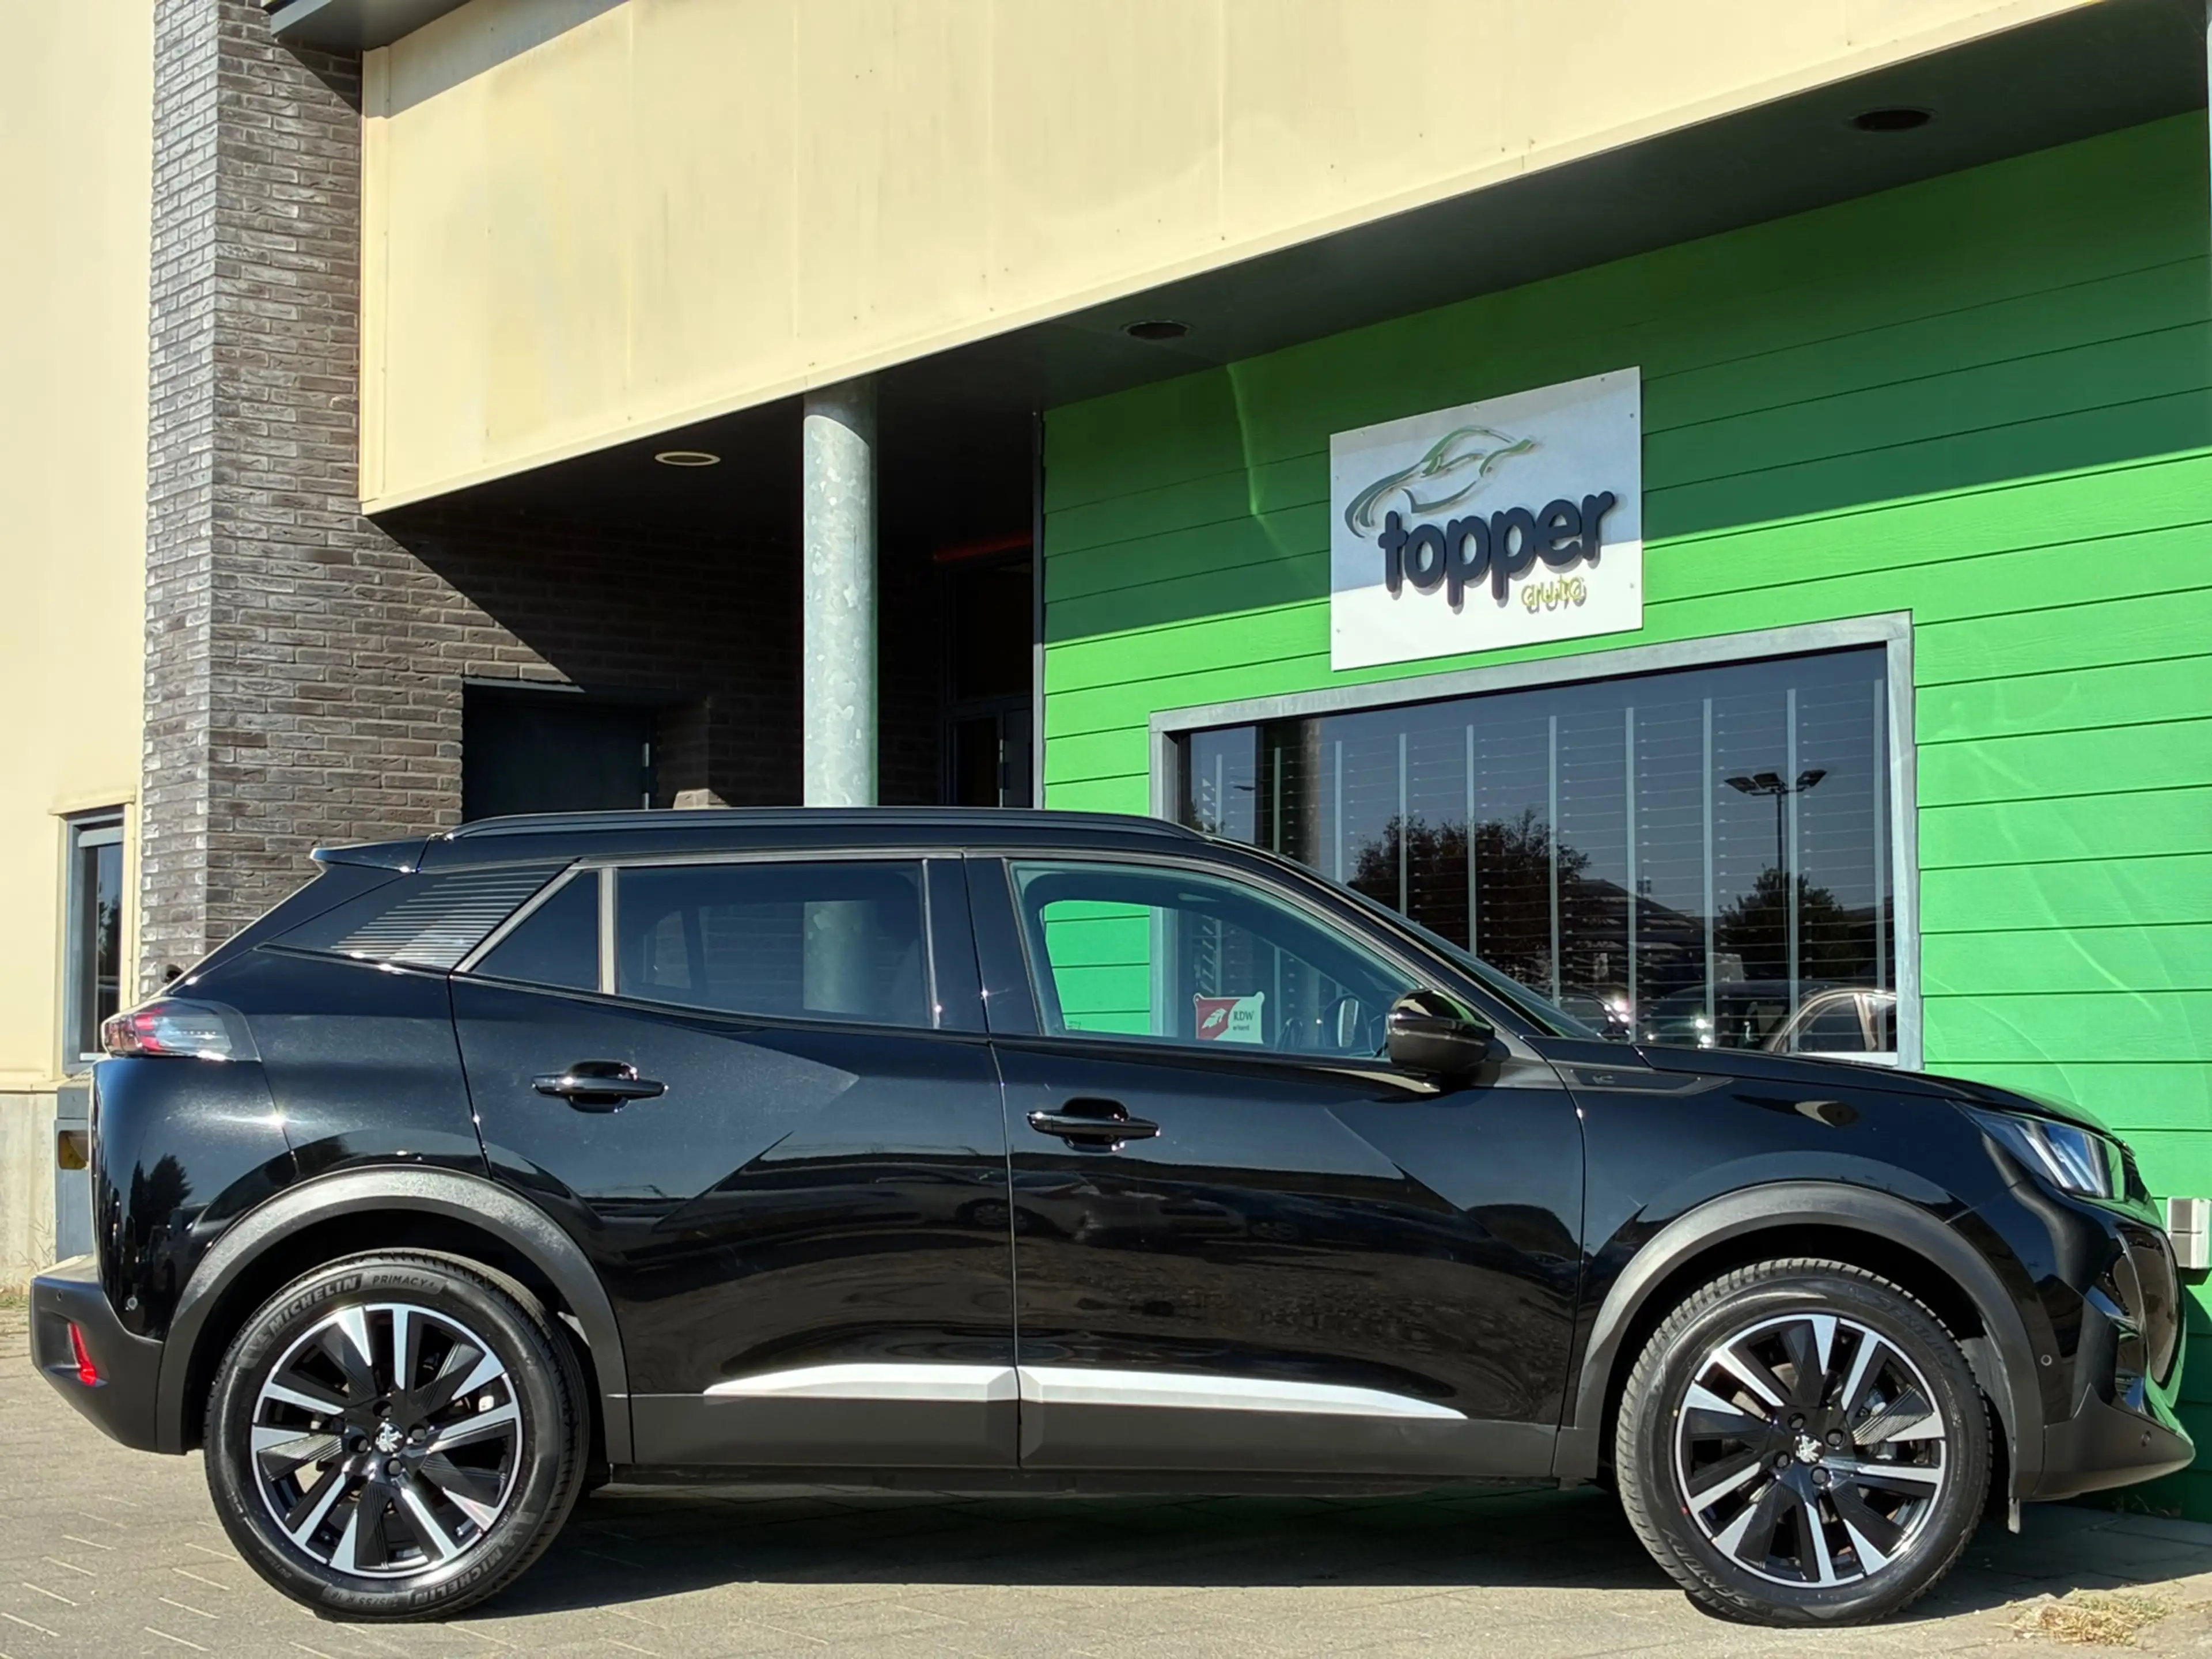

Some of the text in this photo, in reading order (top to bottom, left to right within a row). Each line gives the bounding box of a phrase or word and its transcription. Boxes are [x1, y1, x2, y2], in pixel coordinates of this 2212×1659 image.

[1378, 490, 1615, 608] topper
[1233, 1010, 1255, 1021] RDW
[271, 1275, 358, 1335] MICHELIN
[372, 1275, 428, 1286] PRIMACY
[415, 1547, 504, 1605] MICHELIN
